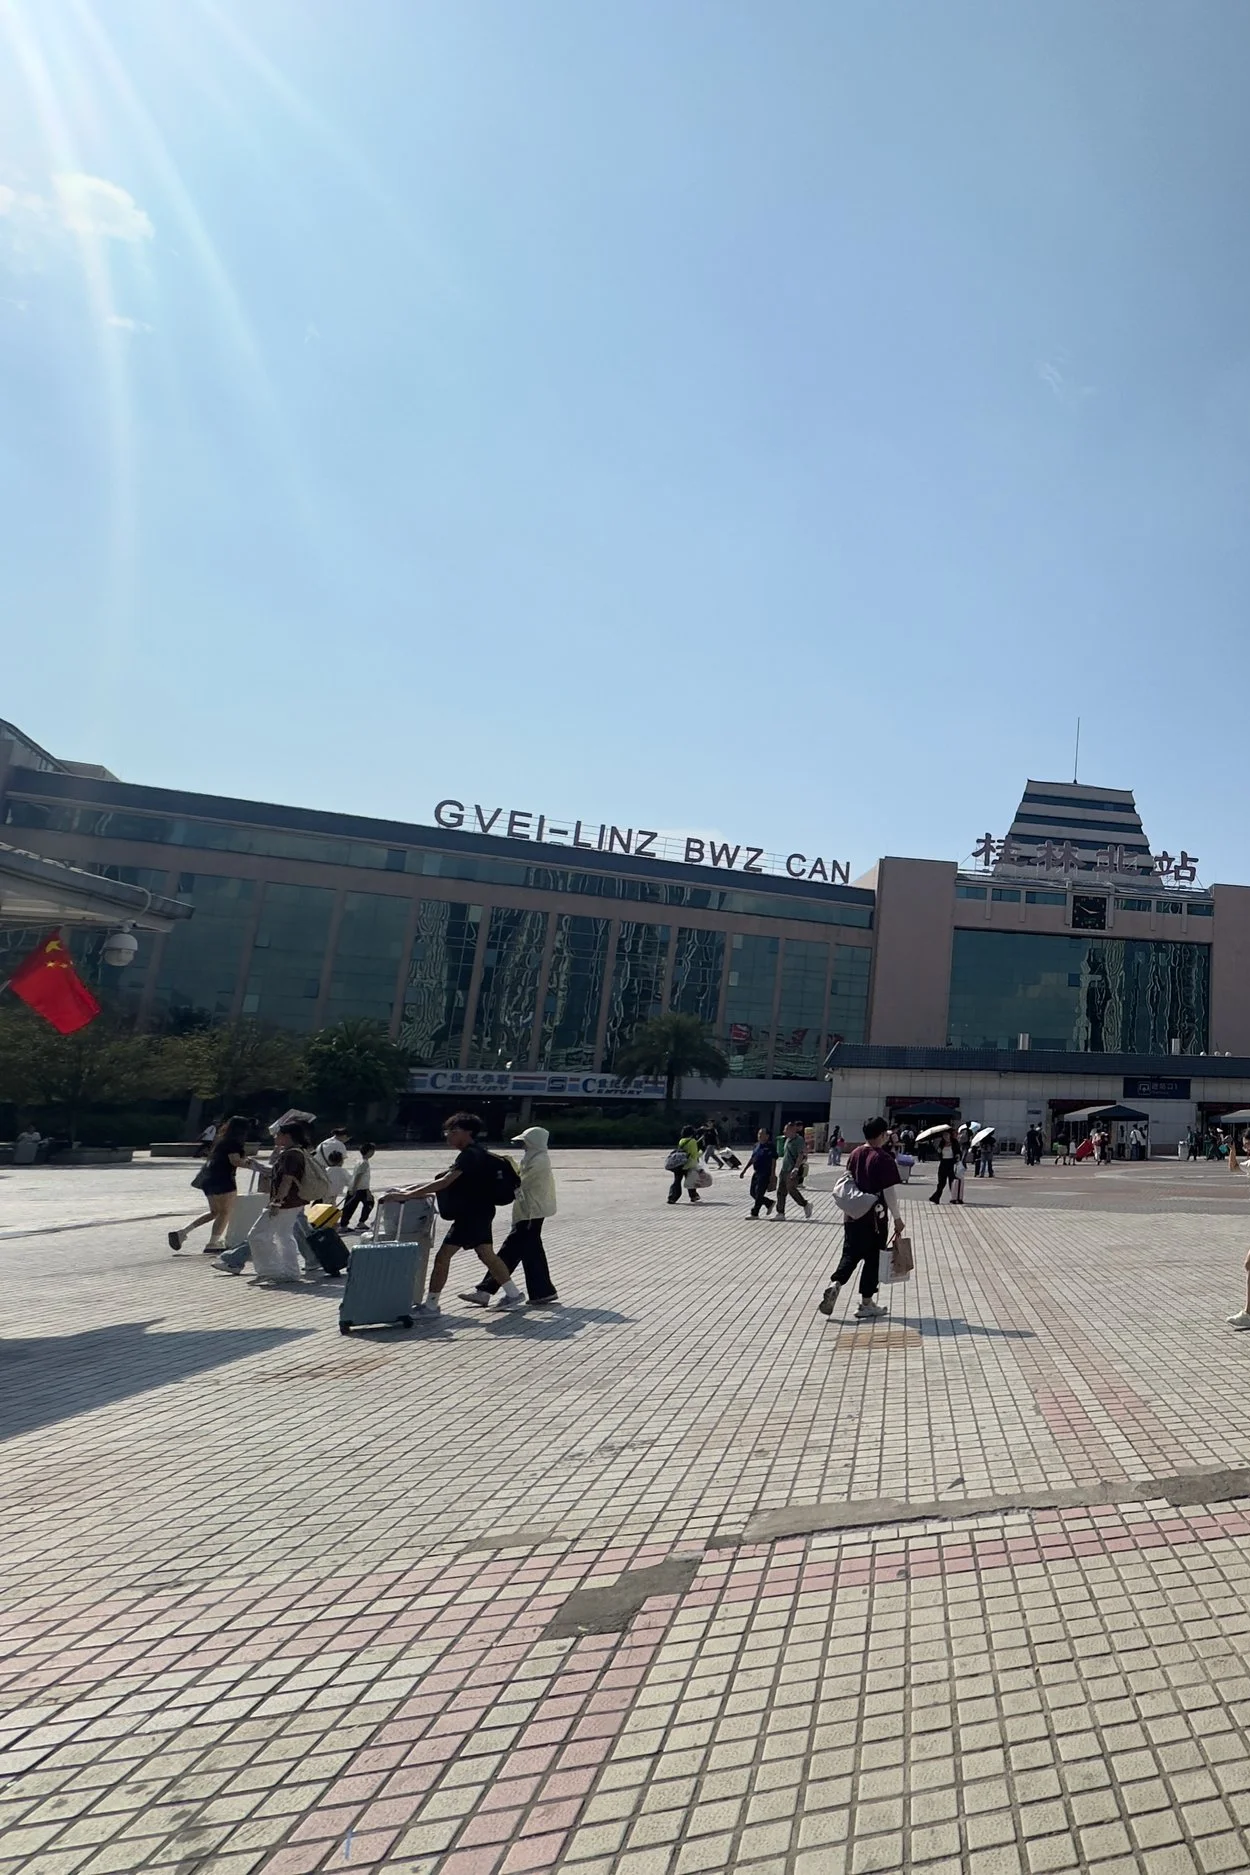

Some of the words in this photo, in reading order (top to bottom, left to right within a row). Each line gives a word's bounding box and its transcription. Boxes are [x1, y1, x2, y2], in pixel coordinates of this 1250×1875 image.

[434, 799, 658, 858] GVEI-LINZ
[684, 837, 765, 873] BWZ
[785, 853, 851, 884] CAN
[971, 832, 1199, 882] 桂林北站
